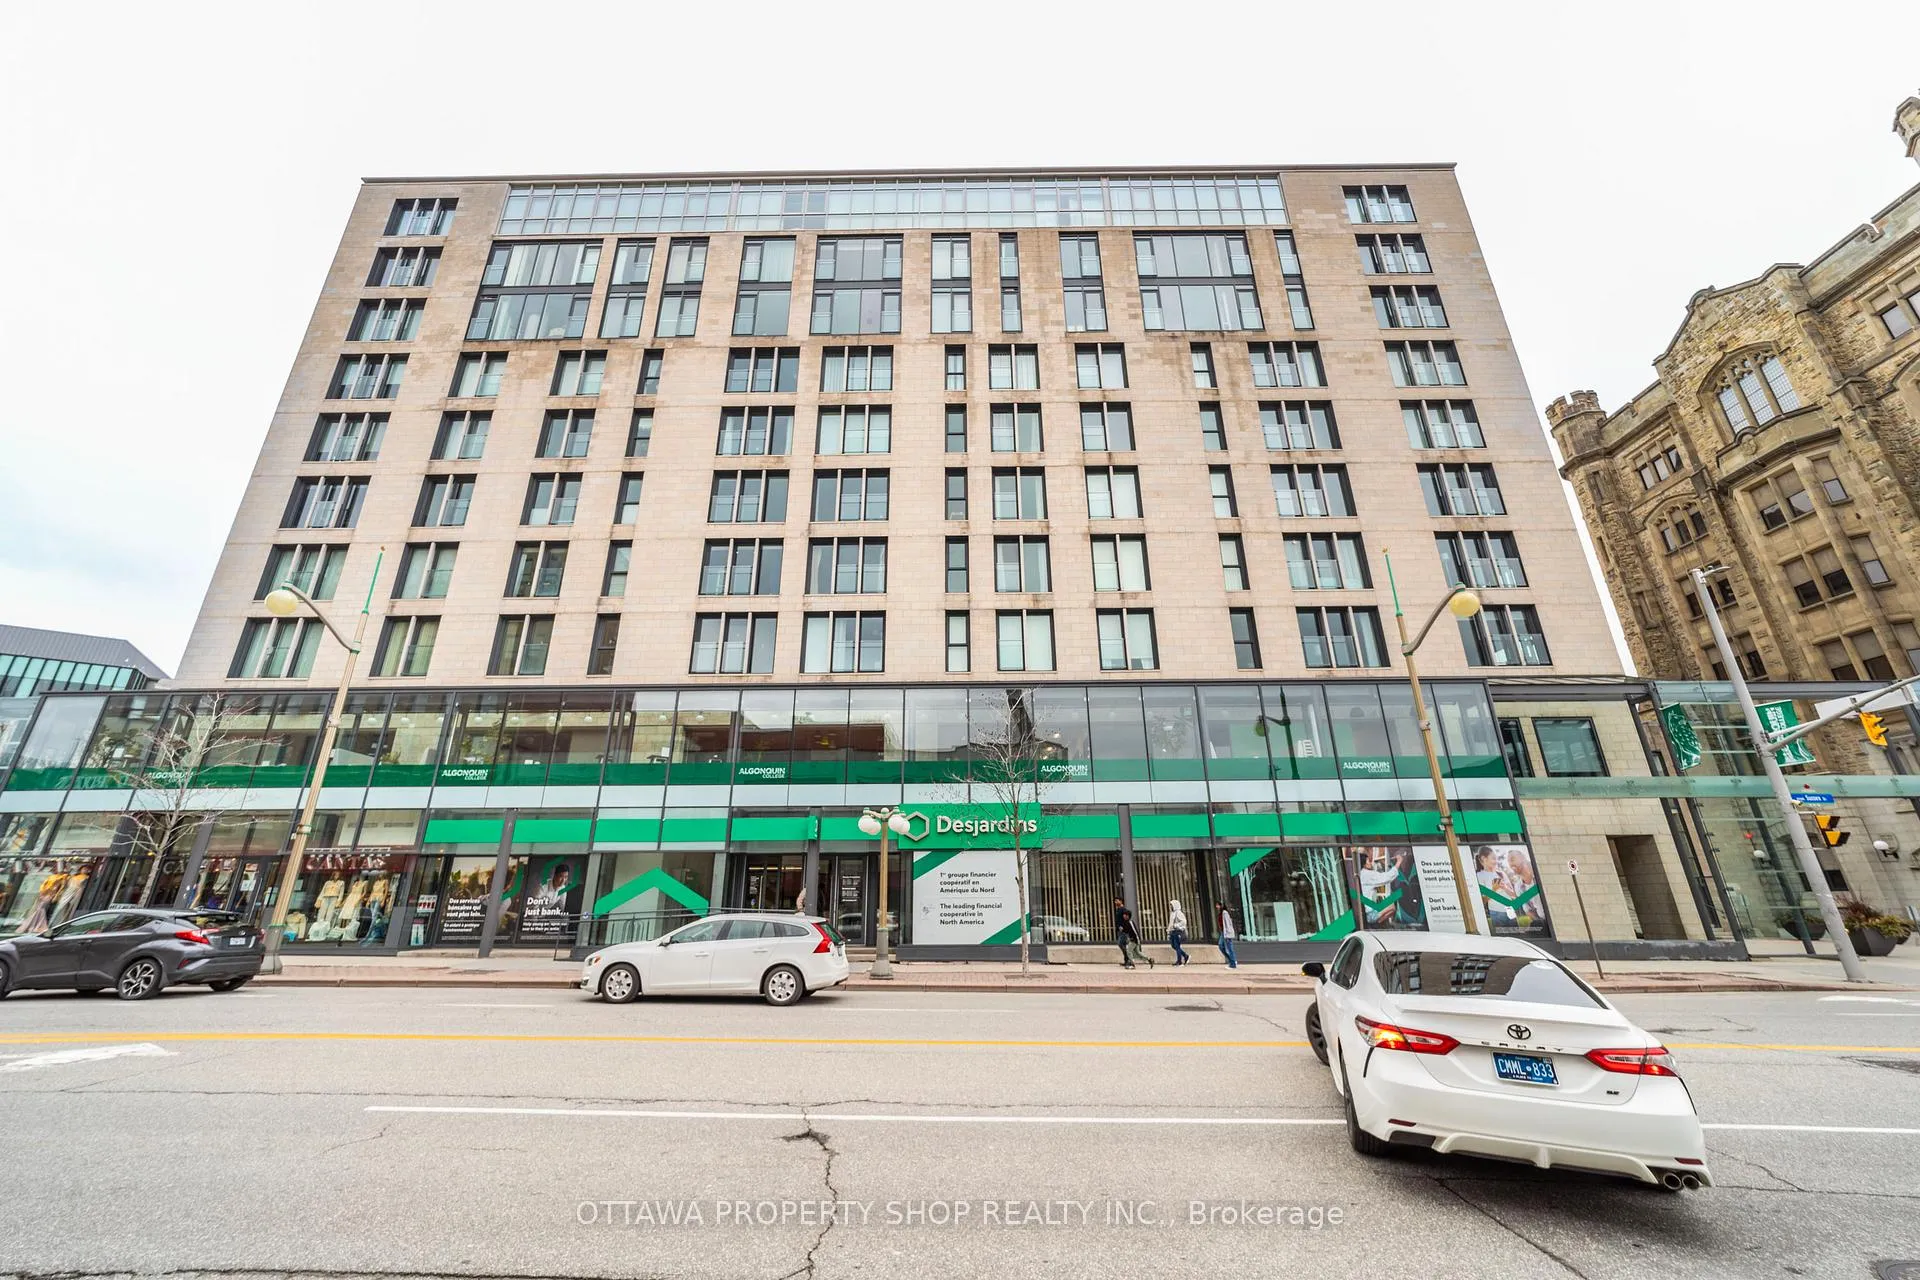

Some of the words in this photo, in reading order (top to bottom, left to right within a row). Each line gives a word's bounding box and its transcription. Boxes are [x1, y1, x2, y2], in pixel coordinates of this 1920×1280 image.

[936, 815, 1038, 837] Desjardins
[524, 908, 540, 917] just
[1498, 1058, 1526, 1075] CMML
[1532, 1063, 1554, 1078] 833
